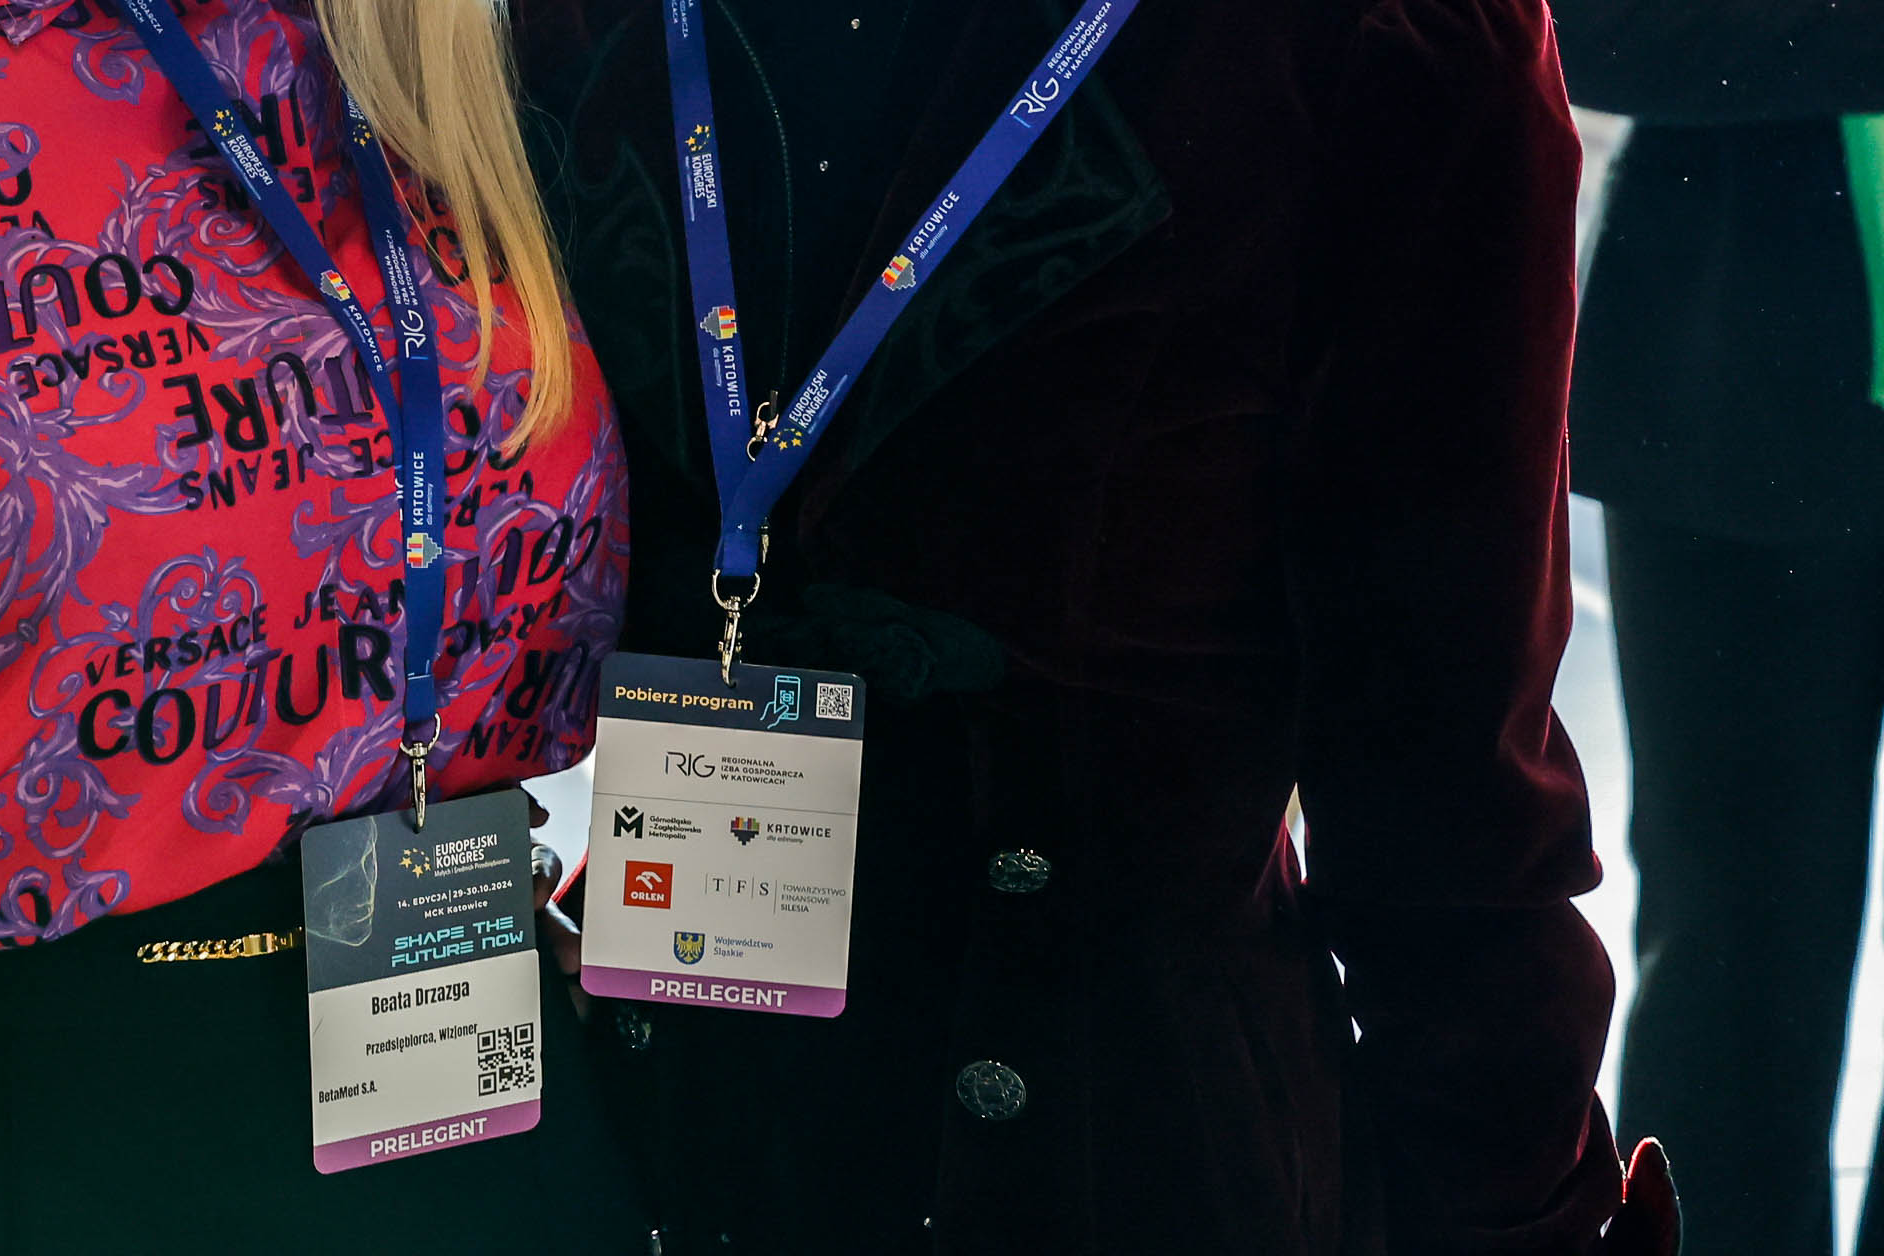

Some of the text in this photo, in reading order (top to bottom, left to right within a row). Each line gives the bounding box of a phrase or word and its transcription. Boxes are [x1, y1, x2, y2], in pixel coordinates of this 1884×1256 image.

[1047, 20, 1086, 69] REGIONALNA
[1056, 1, 1112, 75] IZBA GOSPODARCZA
[1063, 22, 1108, 80] W KATOWICACH
[1010, 77, 1059, 129] RIG
[227, 138, 258, 179] KONGRES
[236, 134, 274, 186] EUROPEJSKI
[692, 155, 706, 199] KONGRES
[701, 153, 717, 209] EUROPEJSKI
[907, 190, 960, 254] KATOWICE
[384, 255, 401, 305] REGIONALNA
[385, 229, 410, 305] IZBA GOSPODARCZA
[397, 246, 417, 296] KATOWICACH
[348, 304, 383, 373] KATOWICE
[400, 309, 429, 360] RIG
[9, 323, 209, 402] VERSACE
[722, 345, 741, 417] KATOWICE
[788, 368, 828, 424] EUROPEJSKI
[798, 385, 830, 430] KONGRES
[178, 441, 316, 512] JEANS
[412, 451, 425, 526] KATOWICE
[84, 602, 269, 687] VERSACE
[74, 620, 397, 767] COUTUR
[615, 685, 754, 712] Pobierz program
[665, 750, 716, 779] RIG
[720, 765, 805, 779] IZBA GOSPODARCZA
[720, 773, 786, 785] W KATOWICACH
[721, 756, 775, 768] REGIONALNA
[435, 833, 498, 857] EUROPEJSKI
[648, 831, 687, 841] Metropolia
[767, 823, 832, 838] KATOWICE
[436, 848, 485, 869] KONGRES
[398, 880, 513, 909] 14. EDYCJA 29-30.10.2024
[630, 890, 665, 903] ORLEN
[780, 903, 810, 913] SILESIA
[781, 894, 831, 905] FINANSOWE
[782, 883, 847, 897] TOWARZYSTWO
[424, 900, 488, 919] MCK Katowice
[395, 915, 514, 951] SHAPE THE
[714, 935, 774, 950] Województwo
[391, 940, 474, 968] FUTURE
[713, 947, 744, 959] Śląskie
[371, 980, 470, 1016] Beata Drzazga
[650, 978, 788, 1008] PRELEGENT
[366, 1023, 478, 1057] Przedsiębiorca, Wizjoner
[318, 1080, 378, 1104] BetaMed S.A.
[370, 1116, 488, 1159] PRELEGENT
